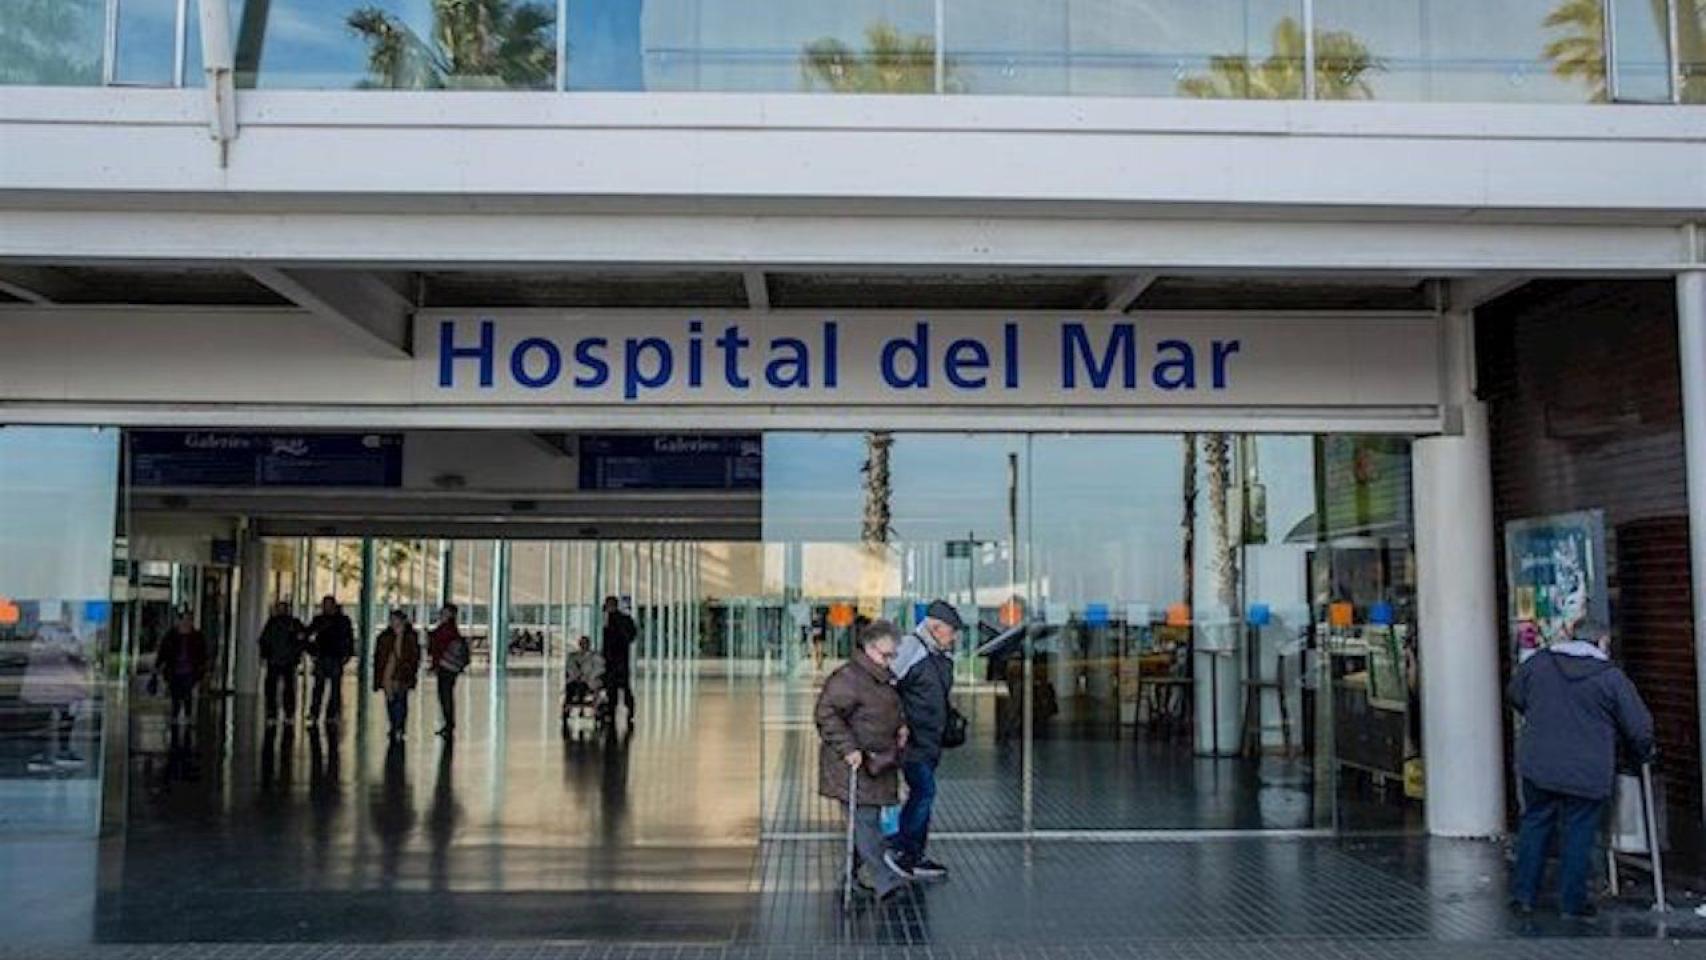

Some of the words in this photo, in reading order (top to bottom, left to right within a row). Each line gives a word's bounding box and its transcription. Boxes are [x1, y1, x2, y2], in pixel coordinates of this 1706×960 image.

[437, 320, 837, 400] Hospital
[880, 322, 1018, 389] del
[1062, 322, 1241, 390] Mar
